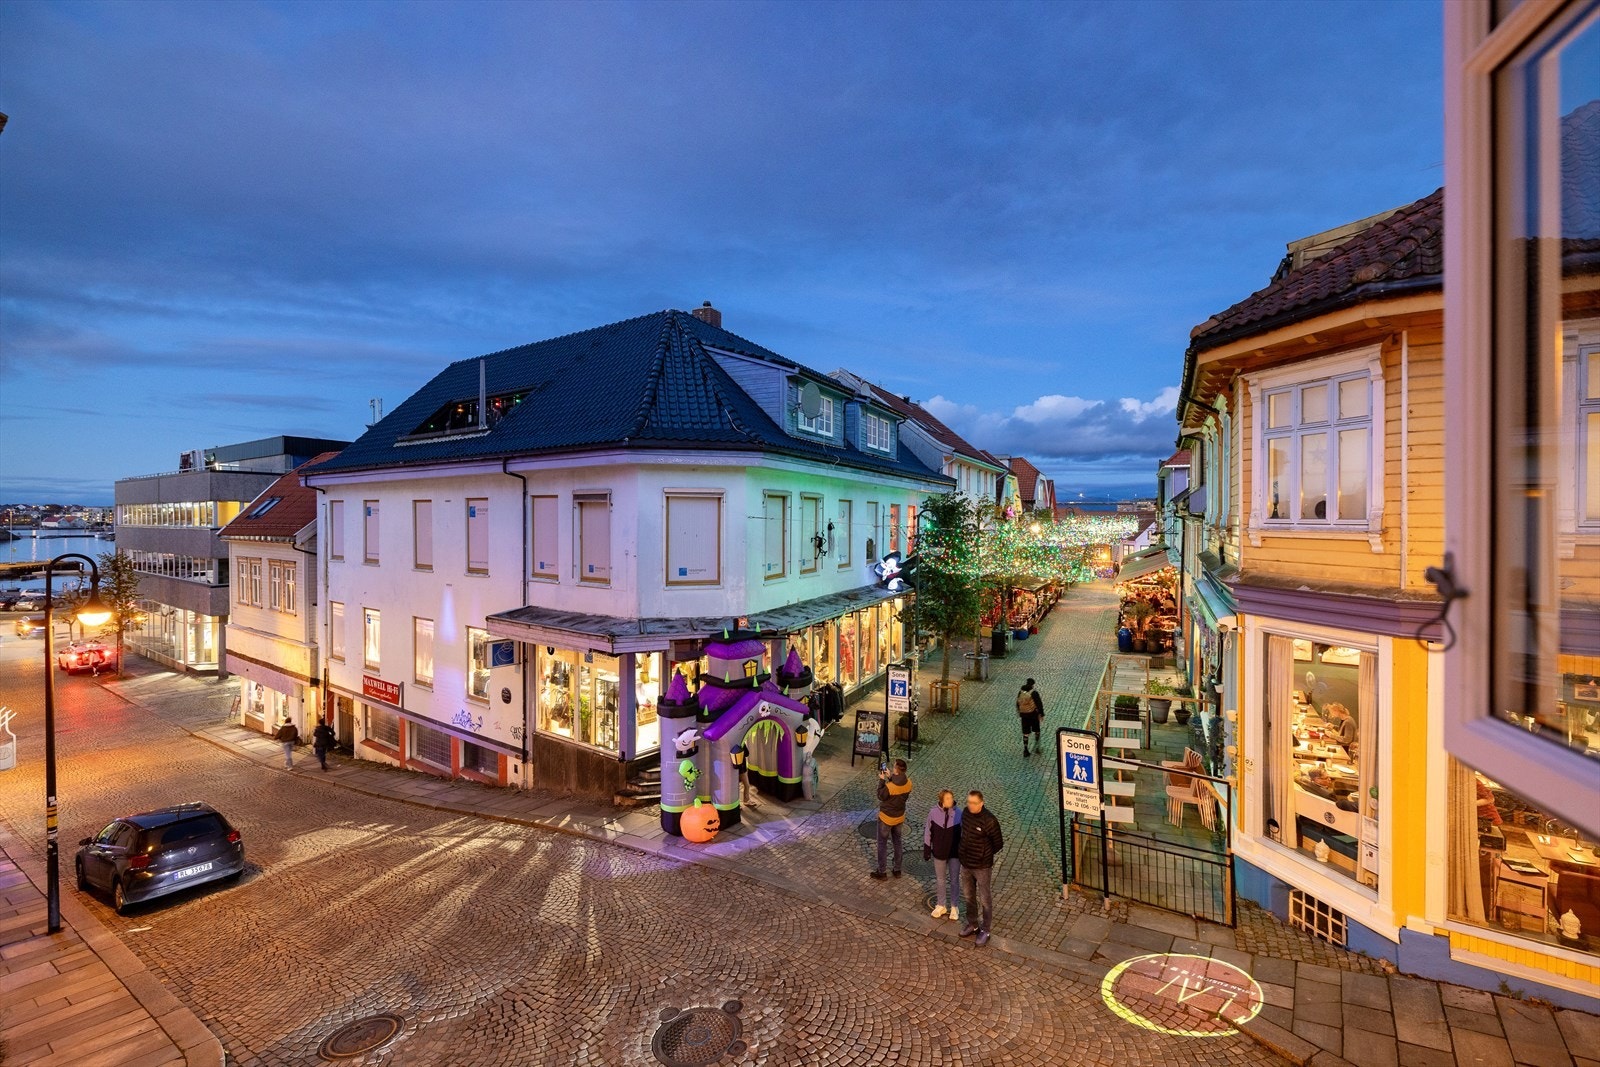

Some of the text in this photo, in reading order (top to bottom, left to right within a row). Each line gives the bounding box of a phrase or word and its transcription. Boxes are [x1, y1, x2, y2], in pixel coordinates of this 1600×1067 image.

[363, 677, 386, 691] MAXWELL
[857, 720, 881, 734] OPEN
[1067, 739, 1090, 750] Sone
[1066, 789, 1097, 800] Varetransport
